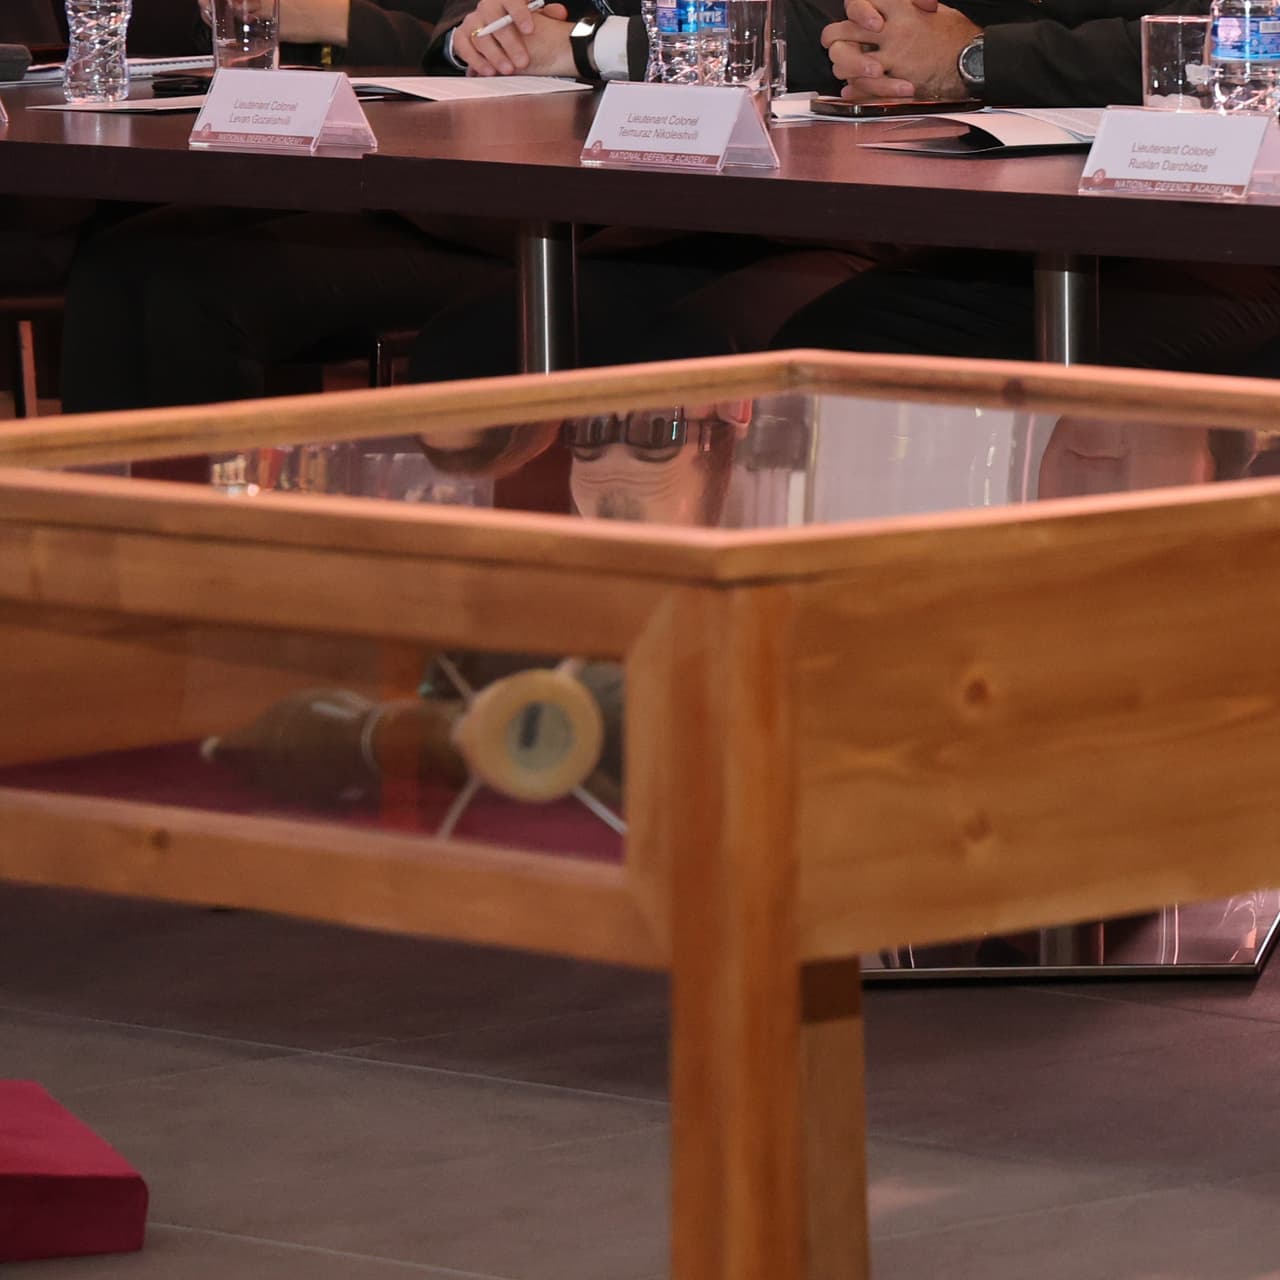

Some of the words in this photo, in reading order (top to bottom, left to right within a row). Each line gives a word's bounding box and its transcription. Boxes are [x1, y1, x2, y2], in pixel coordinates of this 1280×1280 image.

[234, 98, 270, 111] Lieutenant
[271, 101, 298, 112] Colonel
[229, 113, 251, 124] Levan
[628, 113, 667, 124] Lieutenant
[669, 115, 699, 126] Colonel
[1132, 142, 1179, 154] Lieutenant
[1181, 144, 1217, 157] Colonel
[609, 152, 641, 161] NATIONAL
[643, 153, 674, 162] DEFENCE
[675, 154, 709, 164] ACADEMY
[1128, 158, 1160, 170] Ruslan
[1162, 160, 1208, 172] Darchidze
[1114, 180, 1152, 190] NATIONAL
[1155, 182, 1192, 192] DEFENCE
[1193, 184, 1234, 194] ACADEMY
